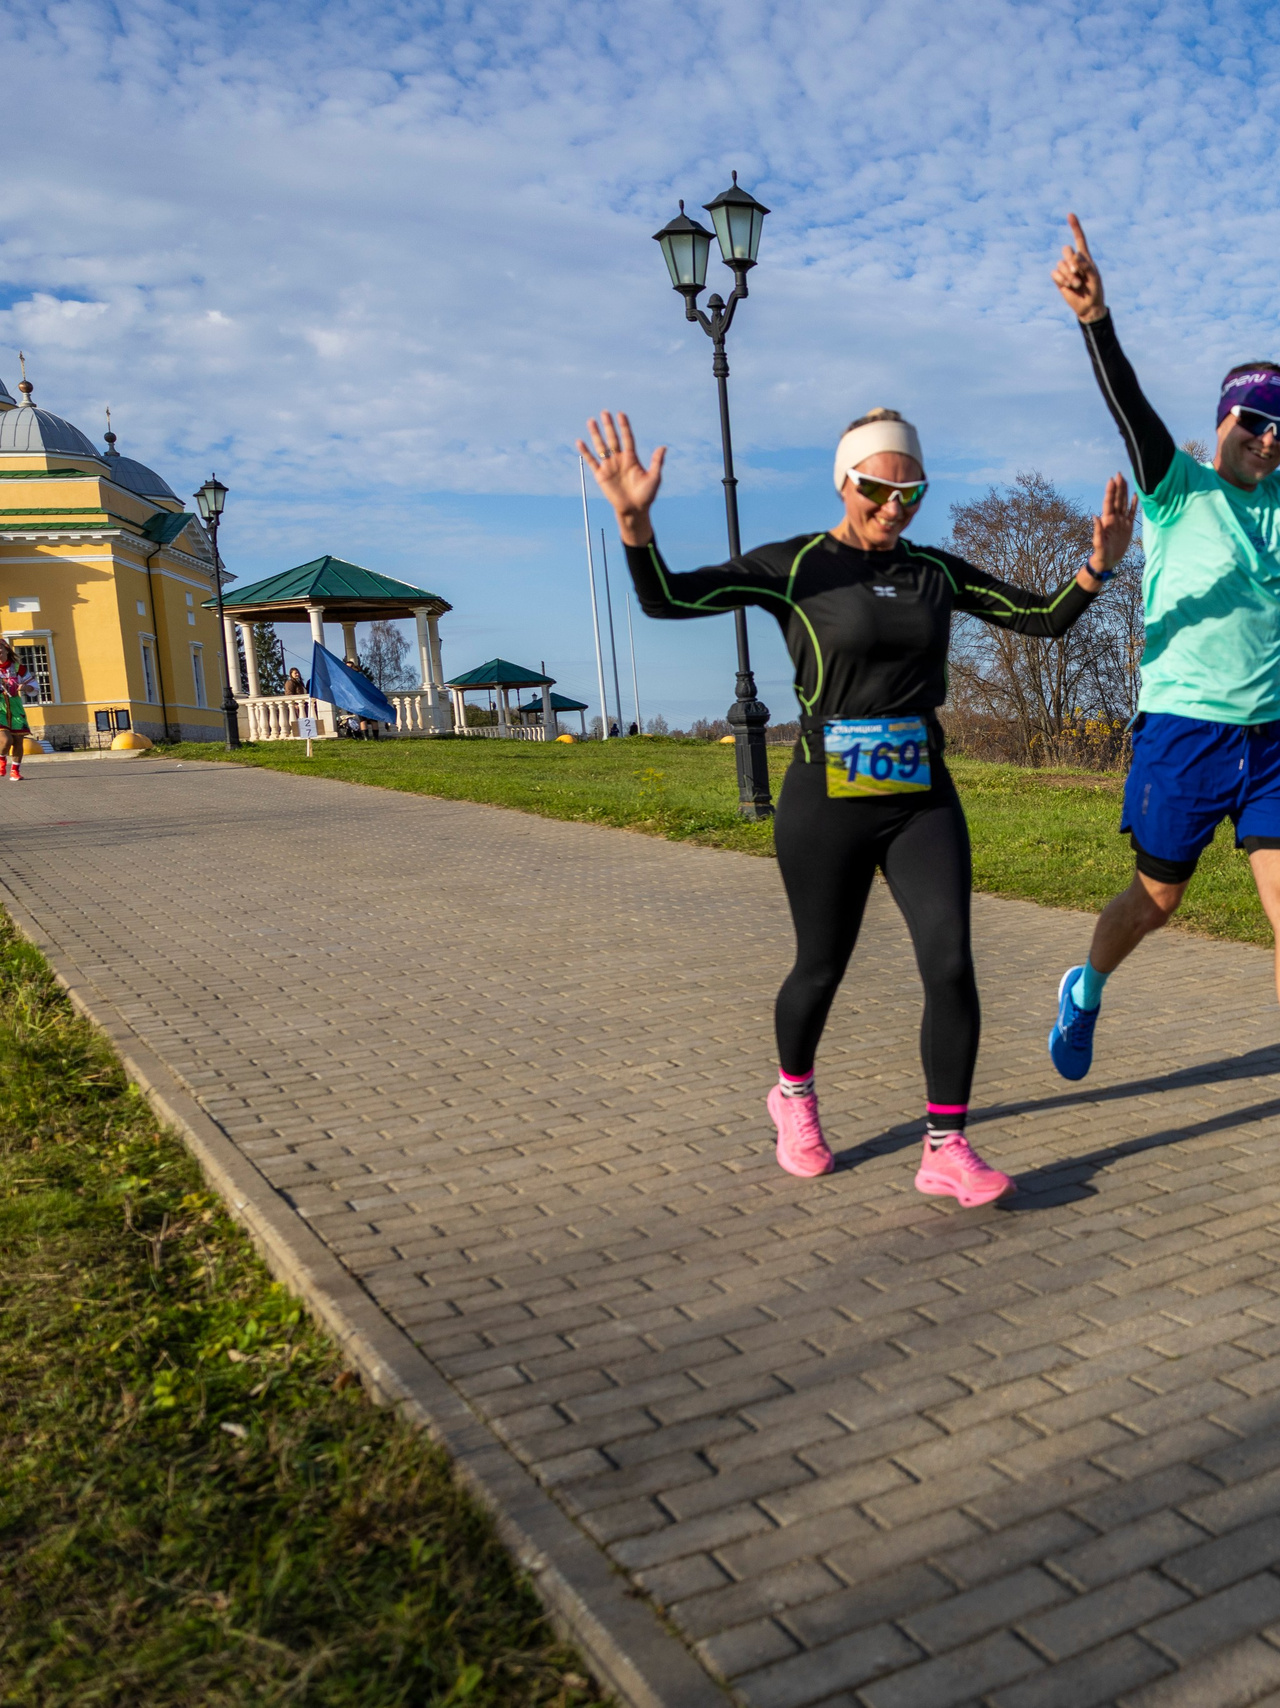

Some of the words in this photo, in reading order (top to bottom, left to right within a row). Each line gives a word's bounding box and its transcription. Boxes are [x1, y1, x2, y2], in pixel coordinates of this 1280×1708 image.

[304, 719, 311, 727] 2
[305, 729, 312, 737] 7
[842, 740, 920, 782] 169
